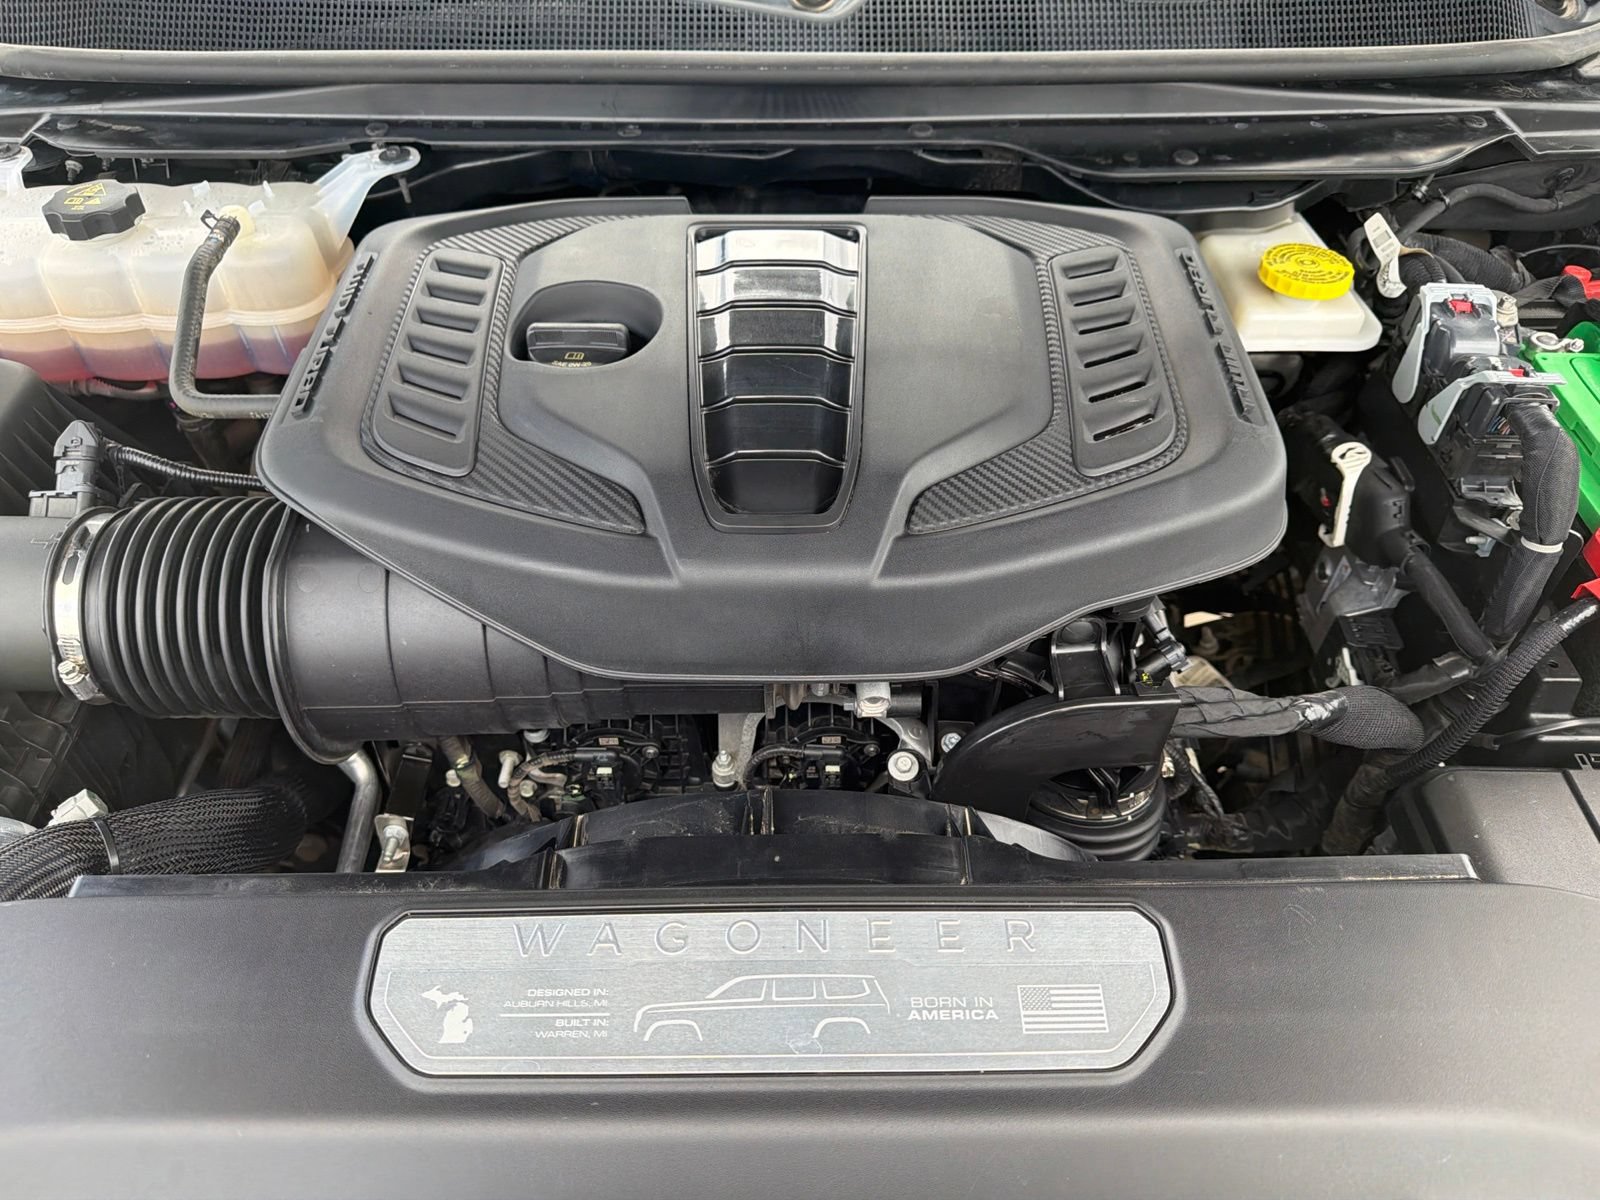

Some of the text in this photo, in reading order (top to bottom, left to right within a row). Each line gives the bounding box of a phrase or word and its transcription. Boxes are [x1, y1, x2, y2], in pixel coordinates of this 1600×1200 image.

[1179, 251, 1225, 339] TURBO
[291, 316, 346, 420] TURBO
[512, 918, 1037, 958] WAGONEER
[527, 988, 609, 997] DESIGNED IN:
[503, 999, 608, 1008] AUBURN HILLS, MI
[910, 996, 993, 1008] BORN IN
[907, 1009, 999, 1021] AMERICA
[555, 1018, 609, 1027] BUILT IN:
[535, 1030, 608, 1039] WARREN, MI
